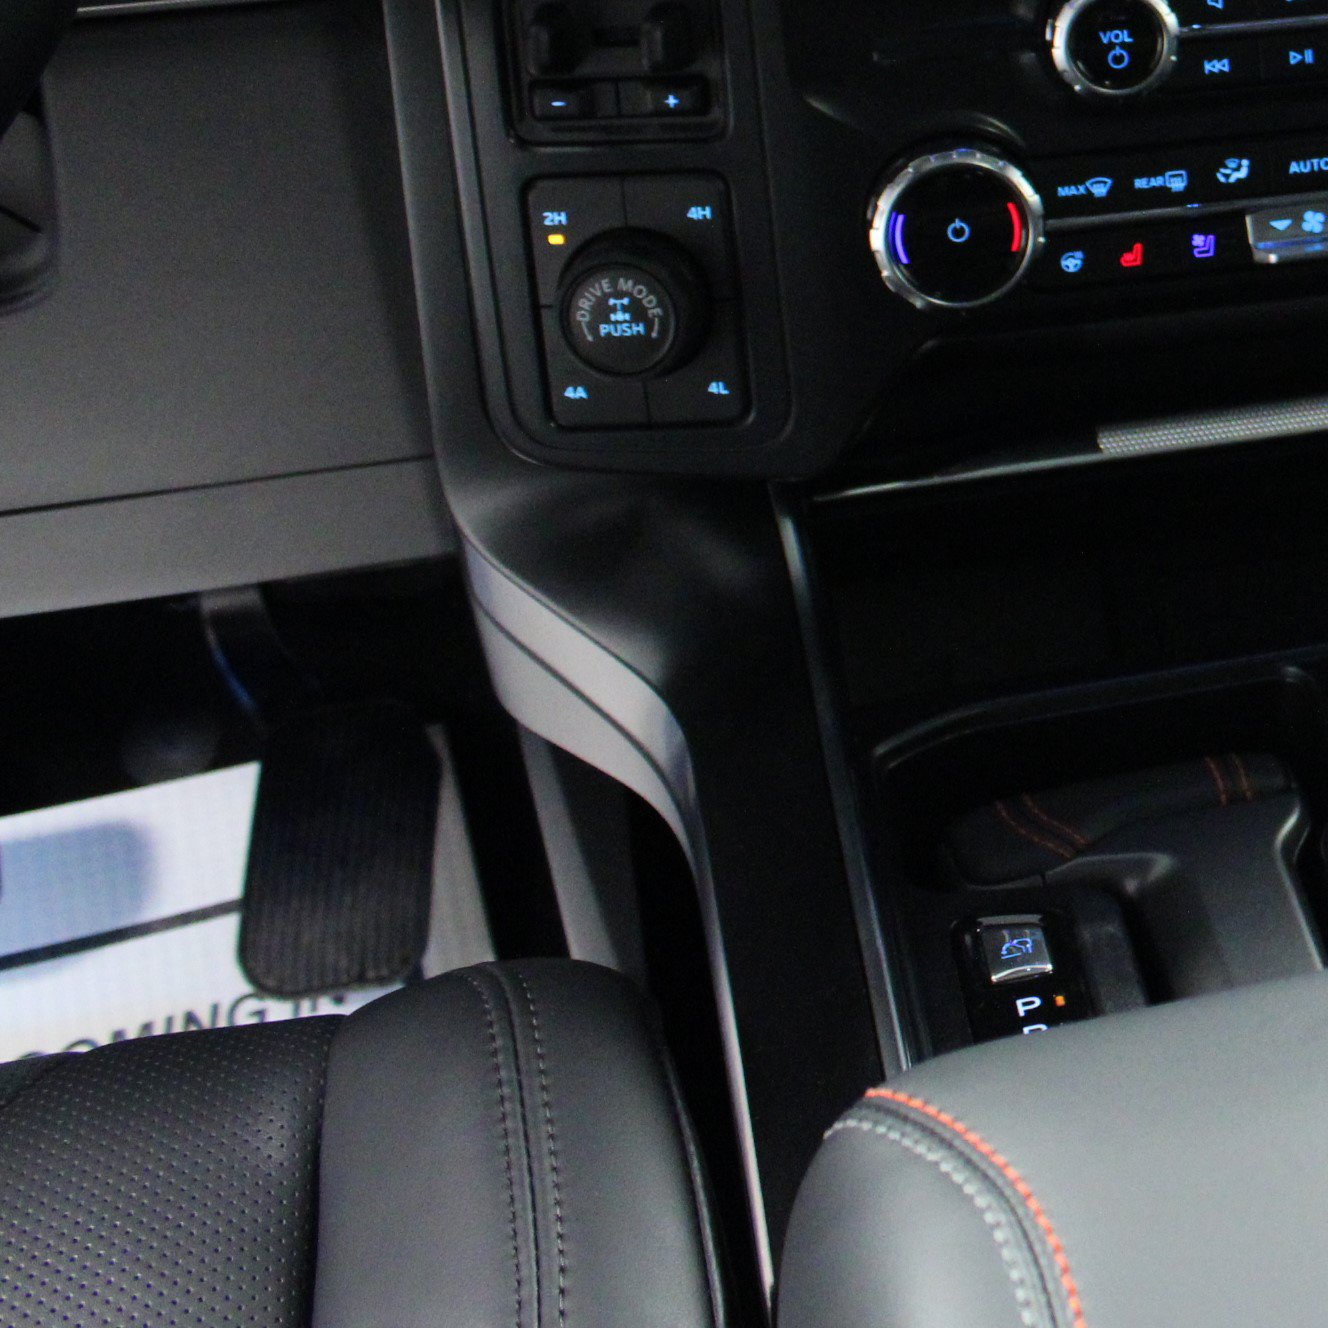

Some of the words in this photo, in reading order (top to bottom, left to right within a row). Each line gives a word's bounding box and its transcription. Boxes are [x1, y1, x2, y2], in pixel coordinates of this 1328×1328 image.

[1098, 29, 1134, 46] VOL
[1133, 175, 1166, 190] REAR
[1057, 184, 1088, 197] MAX
[542, 211, 568, 226] 2H
[686, 206, 713, 221] 4H
[576, 278, 614, 323] DRIVE
[617, 277, 664, 319] MODE
[599, 322, 646, 338] PUSH
[563, 386, 590, 400] 4A
[707, 381, 731, 395] 4L
[1015, 996, 1042, 1018] P
